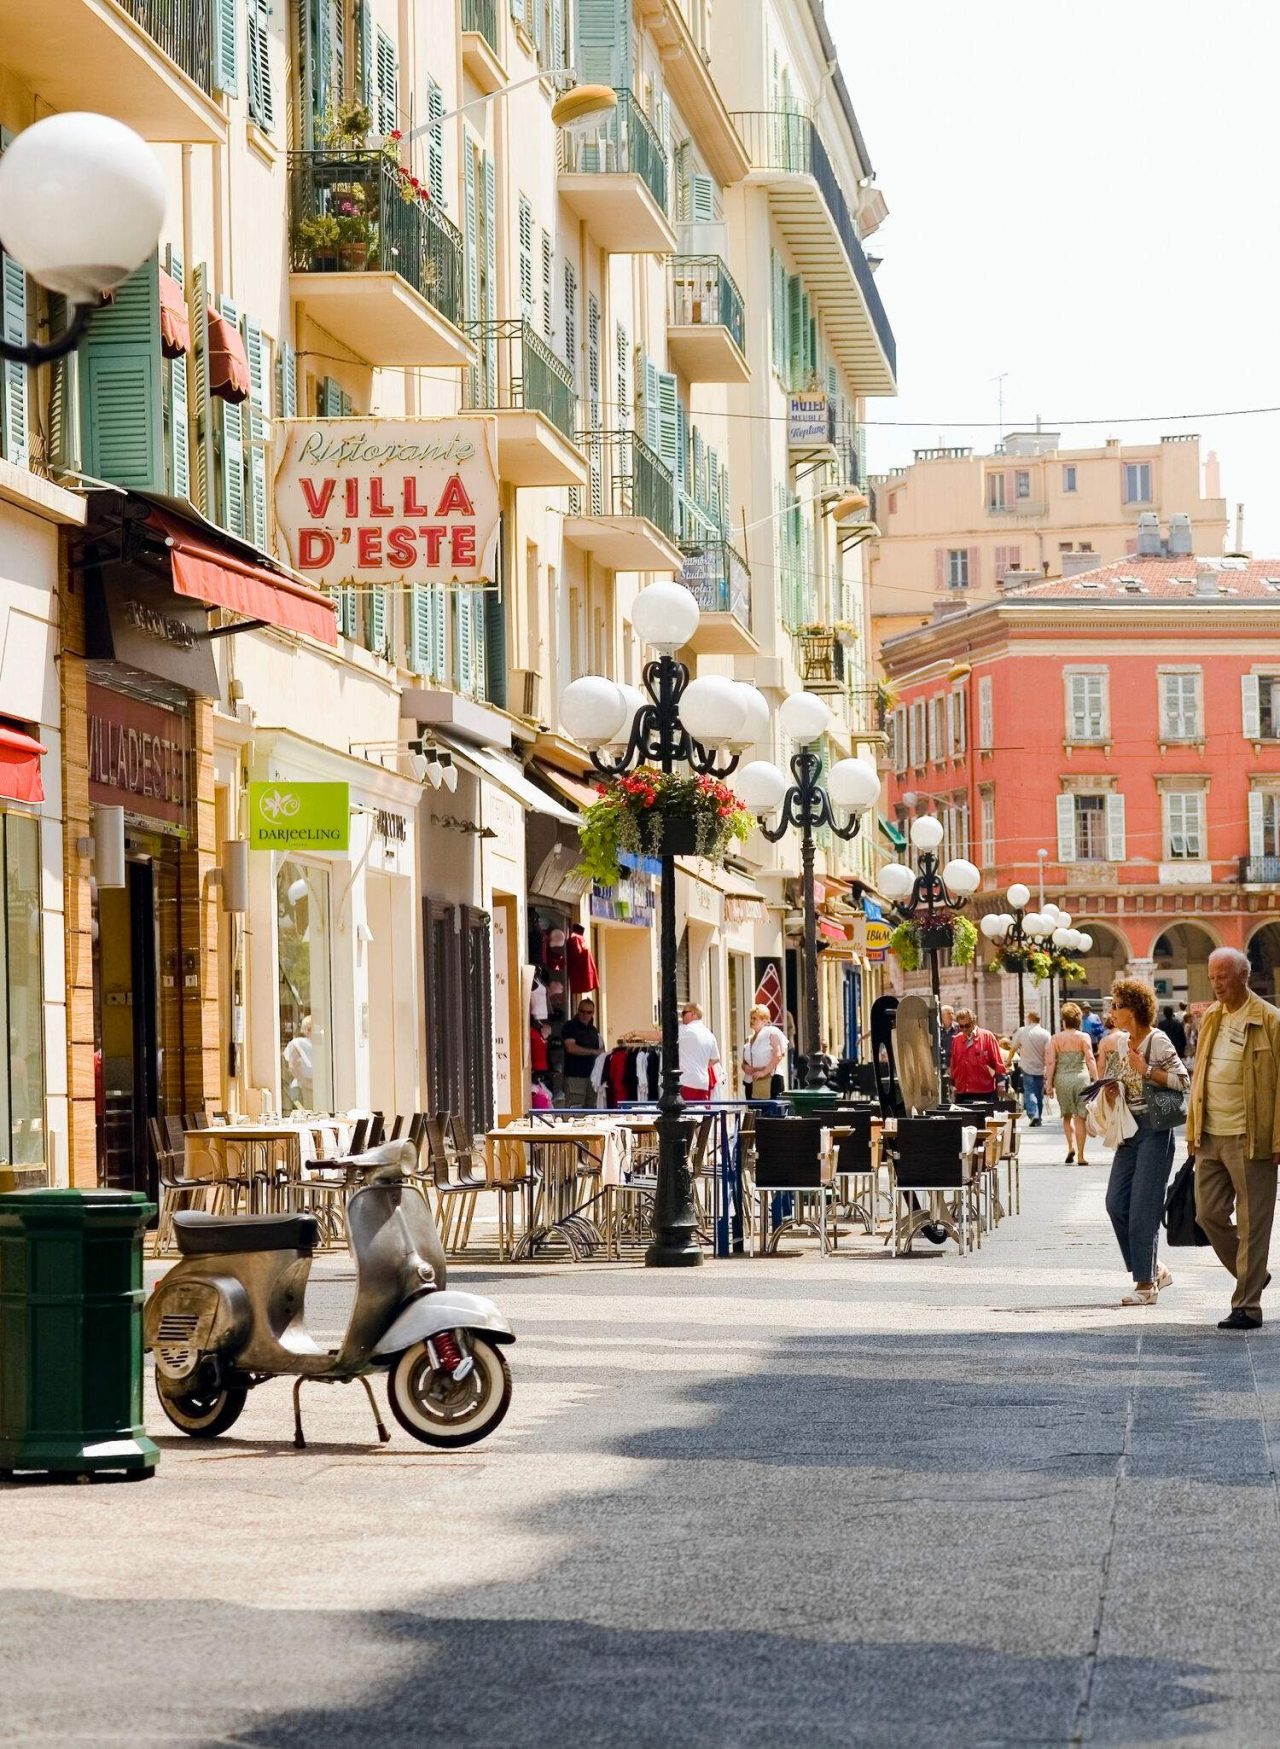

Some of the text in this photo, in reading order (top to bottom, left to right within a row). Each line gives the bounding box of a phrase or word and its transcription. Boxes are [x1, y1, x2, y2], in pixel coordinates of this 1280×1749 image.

[298, 431, 476, 462] Ristorante
[298, 475, 476, 519] VILLA
[298, 525, 476, 569] D'ESTE
[867, 929, 890, 942] LBUM
